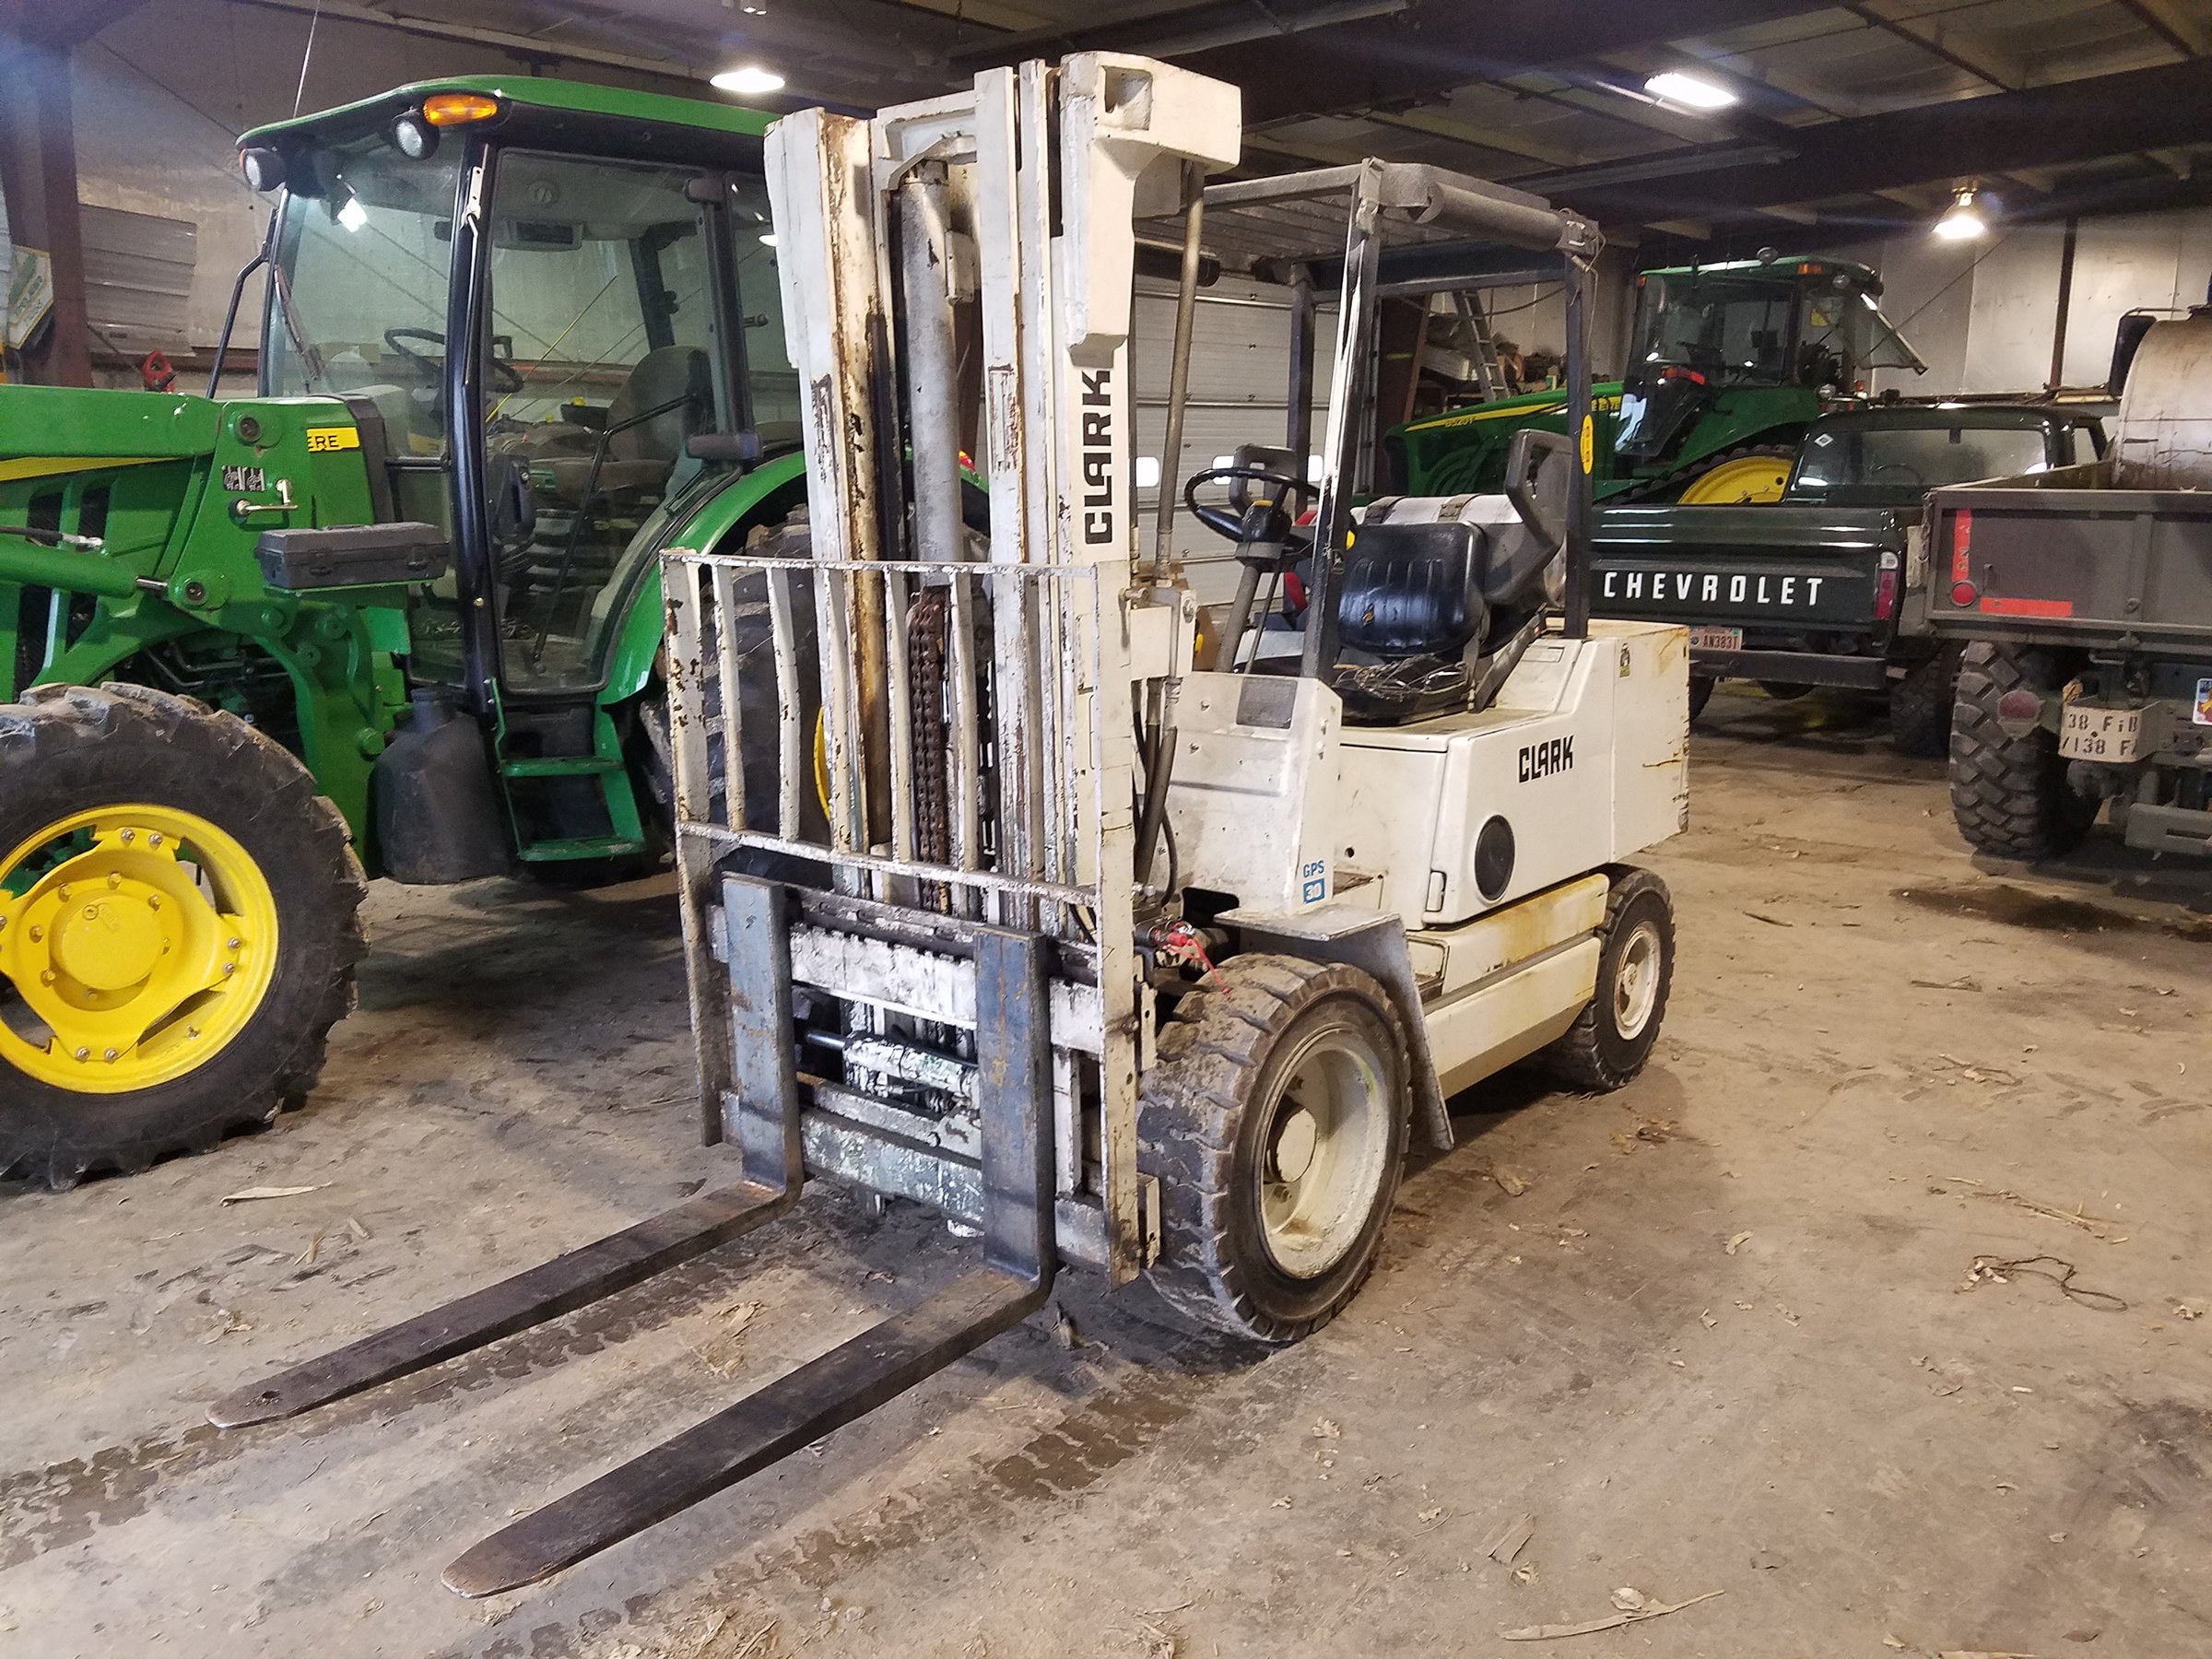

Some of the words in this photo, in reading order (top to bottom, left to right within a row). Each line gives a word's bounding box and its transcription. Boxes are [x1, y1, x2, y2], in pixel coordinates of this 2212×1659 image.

[1082, 371, 1112, 544] CLARK
[1604, 571, 1823, 606] CHEVROLET
[2068, 714, 2088, 730] 38
[1519, 735, 1574, 783] CLARK
[1303, 860, 1324, 877] GPS
